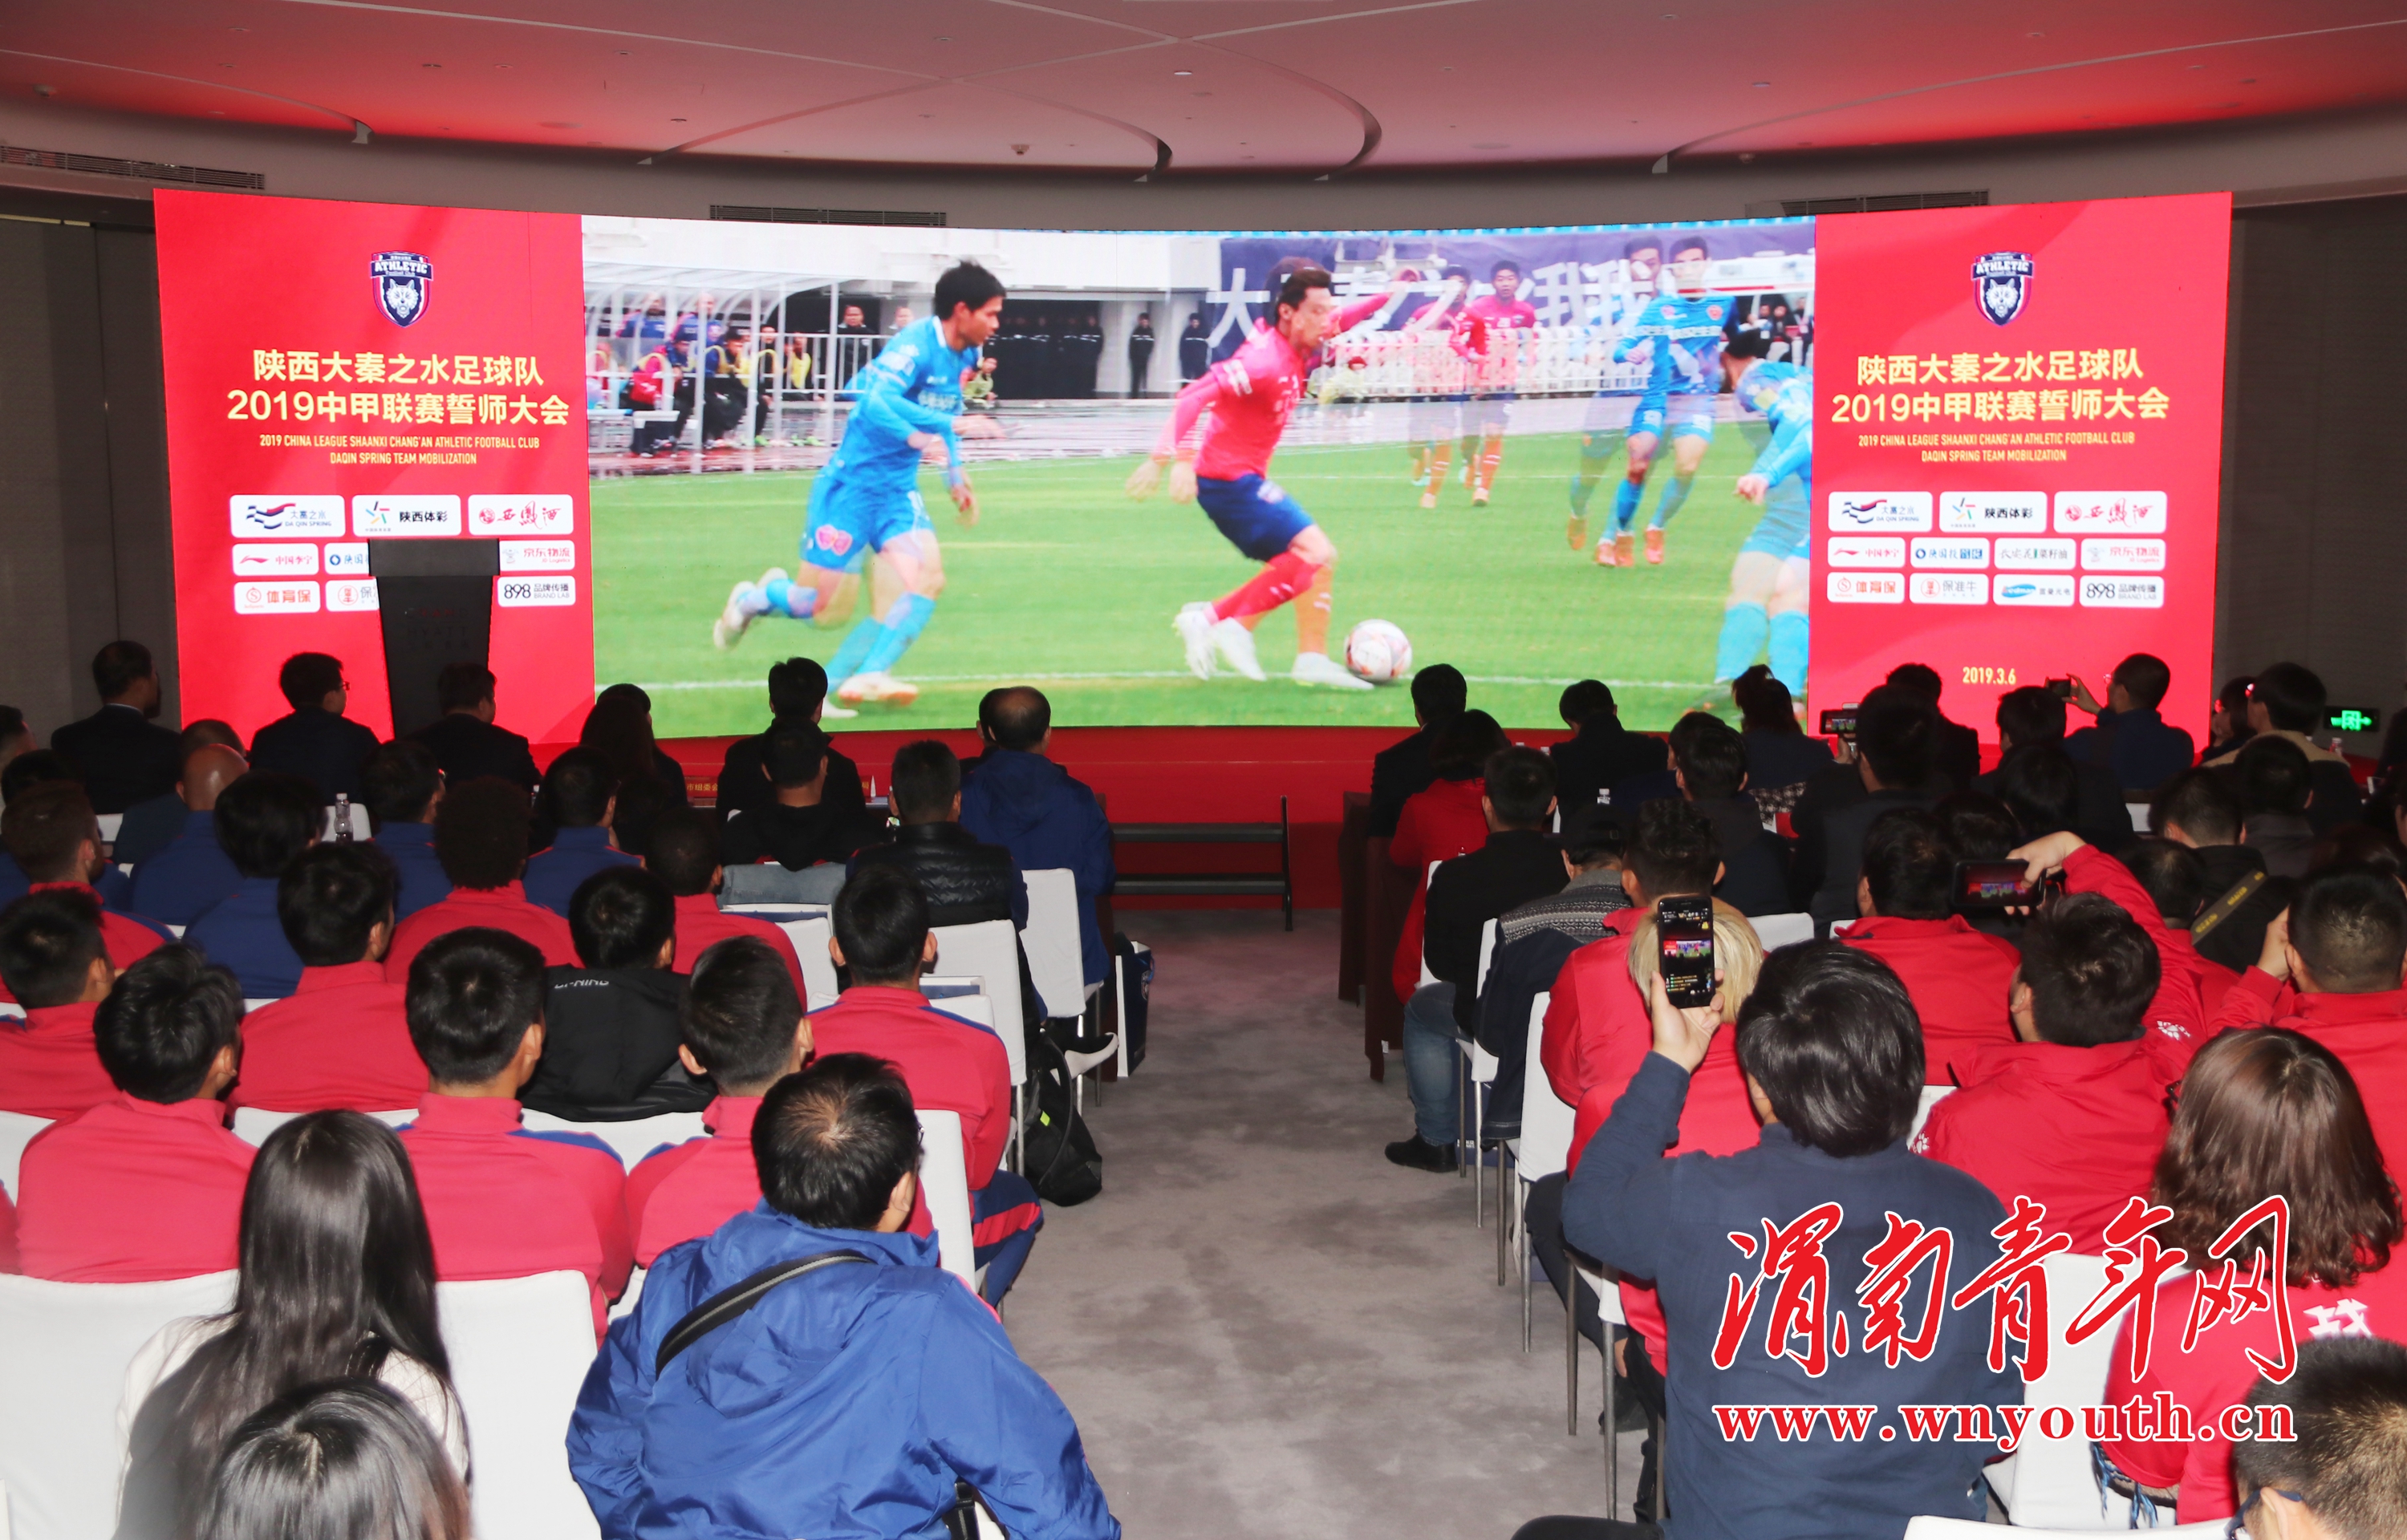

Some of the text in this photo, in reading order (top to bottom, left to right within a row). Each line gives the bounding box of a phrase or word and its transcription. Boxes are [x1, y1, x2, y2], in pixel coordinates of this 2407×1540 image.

[374, 261, 428, 274] ATHLETIC
[1975, 260, 2030, 274] ATHLETIC
[253, 349, 545, 387] 陕西大秦之水足球队
[1857, 347, 2145, 387] 陕西大秦之水足球队
[226, 389, 570, 427] 2019中甲联赛誓师大会
[1830, 386, 2170, 424] 2019中甲联赛誓师大会
[259, 434, 541, 449] 2019 CHINA LEAGUE SHAANXI CHANG'AN ATHLETIC FOOTBALL CLUB
[1857, 431, 2136, 448] 2019 CHINA LEAGUE SHAANXI CHANG'AN ATHLETIC FOOTBALL CLUB
[330, 452, 477, 464] DAQIN SPRING TEAM MOBILIZATION
[1921, 448, 2068, 463] DAQIN SPRING TEAM MOBILIZATION
[399, 510, 448, 523] 陕西体彩
[1984, 507, 2033, 519] 陕西体彩
[523, 547, 570, 558] 京东物流
[1865, 548, 1900, 558] 中国李宁
[2109, 546, 2160, 557] 京东物流
[274, 555, 313, 565] 中国李宁
[503, 583, 531, 599] 898
[533, 583, 570, 592] 品牌传播
[1856, 581, 1897, 594] 体育保
[1942, 580, 1977, 592] 保准牛
[2086, 582, 2116, 599] 898
[2118, 583, 2157, 593] 品牌传播
[266, 589, 311, 603] 体育保
[1962, 666, 2017, 686] 2019.3.6
